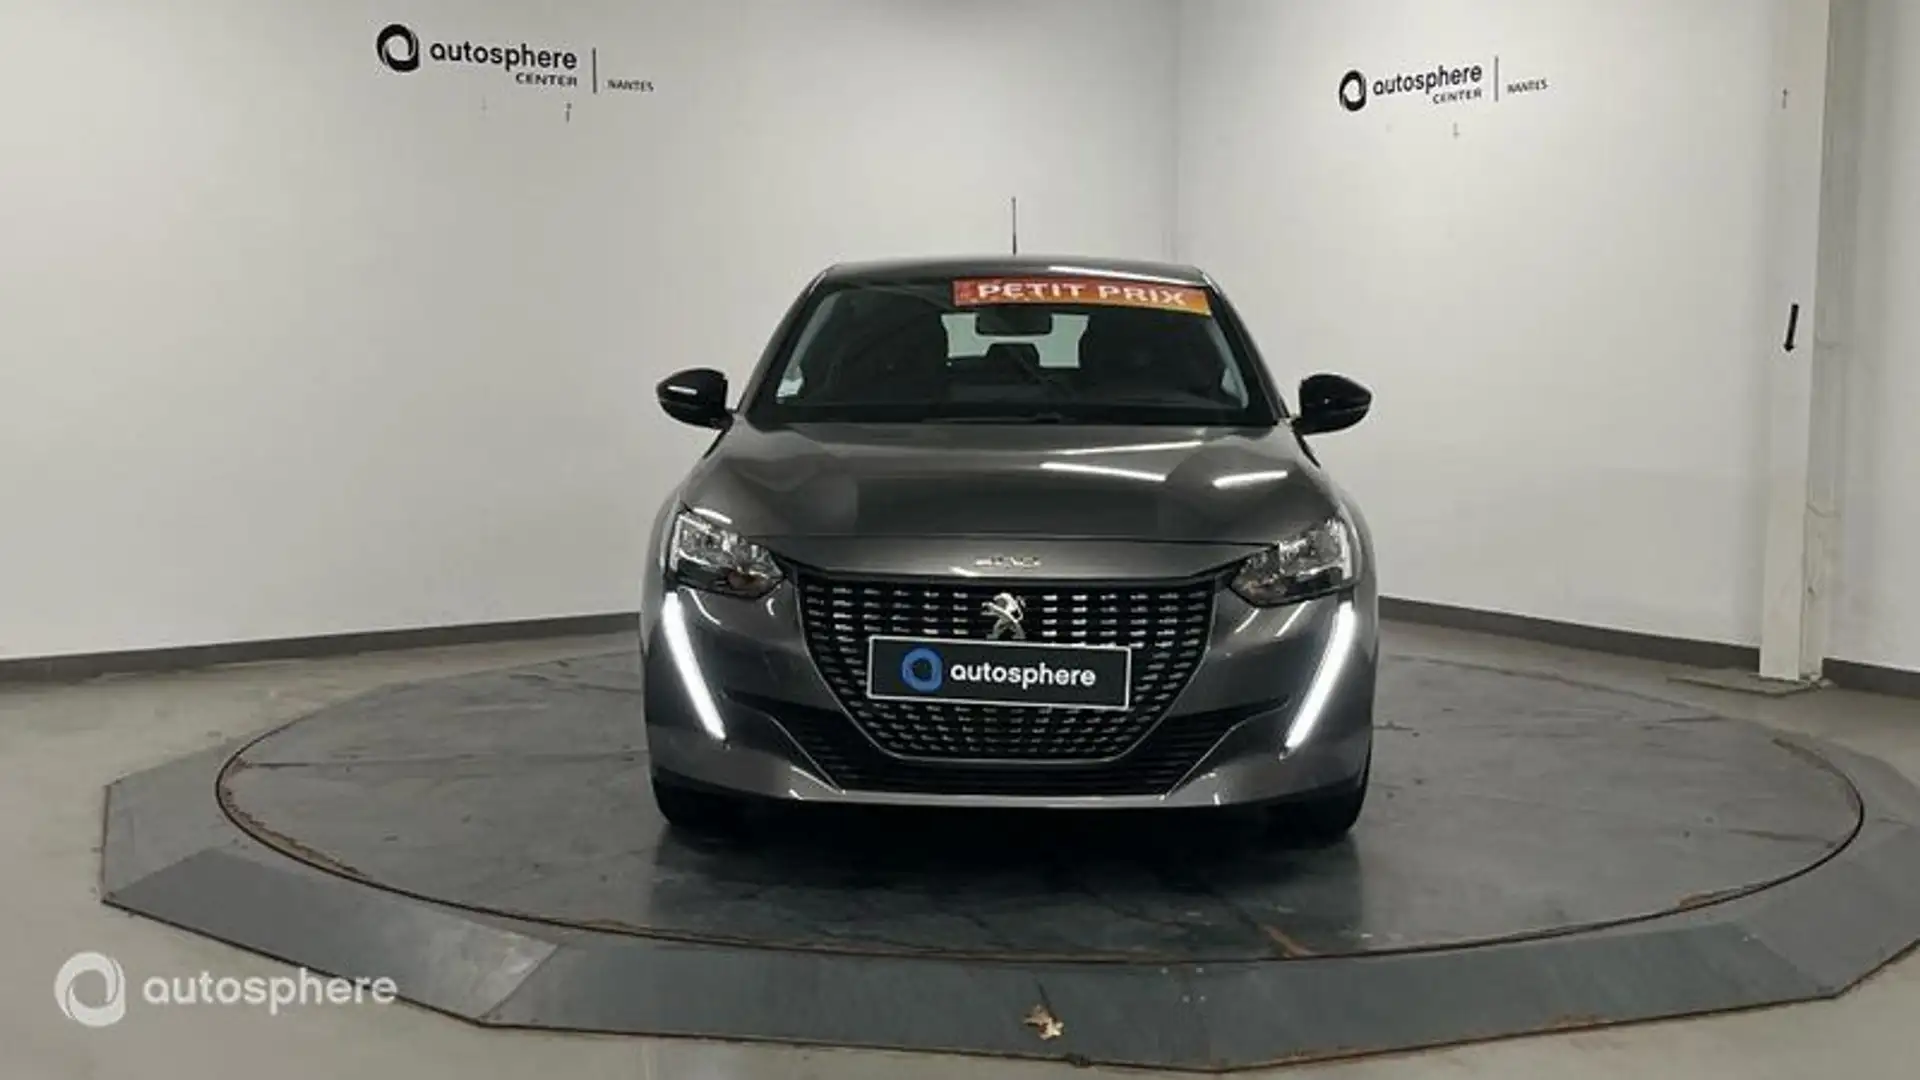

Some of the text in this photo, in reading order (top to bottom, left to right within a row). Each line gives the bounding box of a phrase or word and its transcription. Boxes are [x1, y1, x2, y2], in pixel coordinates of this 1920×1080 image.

[430, 41, 577, 71] autosphere
[516, 72, 577, 86] CENTER
[1373, 65, 1482, 95] autosphere
[1433, 88, 1482, 104] CENTER
[977, 282, 1187, 306] PETIT PRIX
[950, 662, 1096, 690] autosphere
